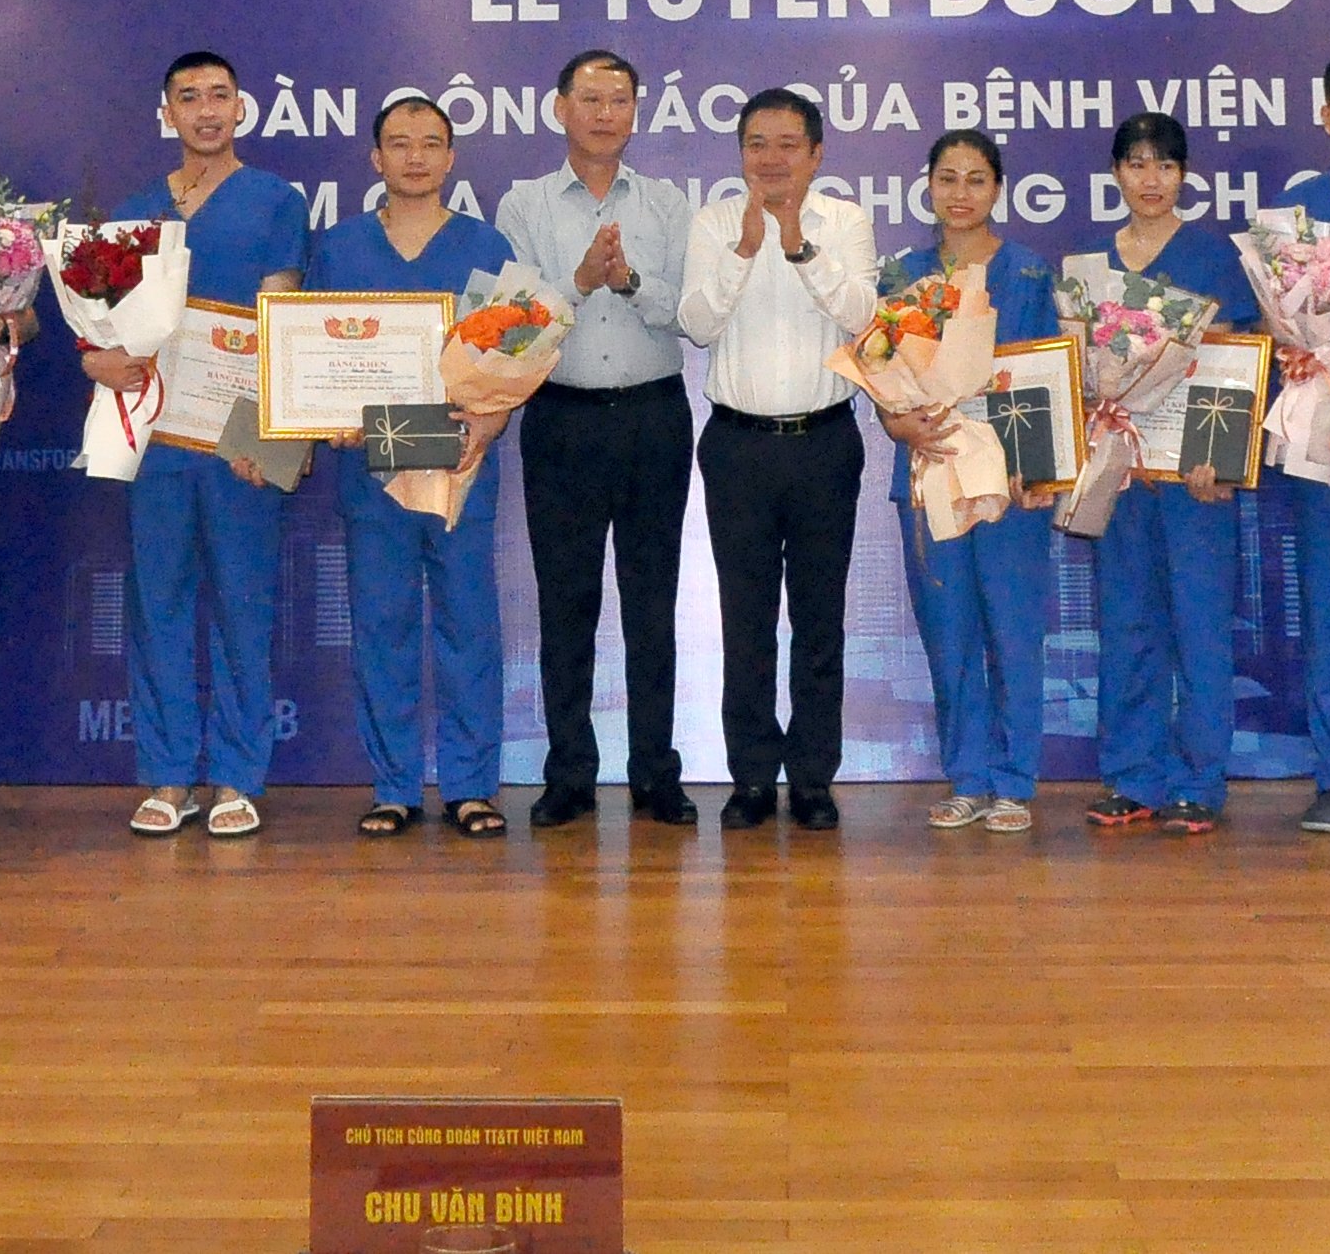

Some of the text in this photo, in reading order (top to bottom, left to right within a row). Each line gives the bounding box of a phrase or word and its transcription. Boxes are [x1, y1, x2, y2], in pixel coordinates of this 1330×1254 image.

[943, 65, 1115, 145] BỆNH
[1136, 63, 1287, 142] VIỆN
[345, 1124, 371, 1145] CHỦ
[407, 1125, 442, 1145] CÔNG
[485, 1128, 519, 1145] TT&TT
[523, 1126, 550, 1148] VIỆT
[554, 1128, 584, 1145] NAM
[365, 1186, 564, 1223] CHU VĂN BÌNH
